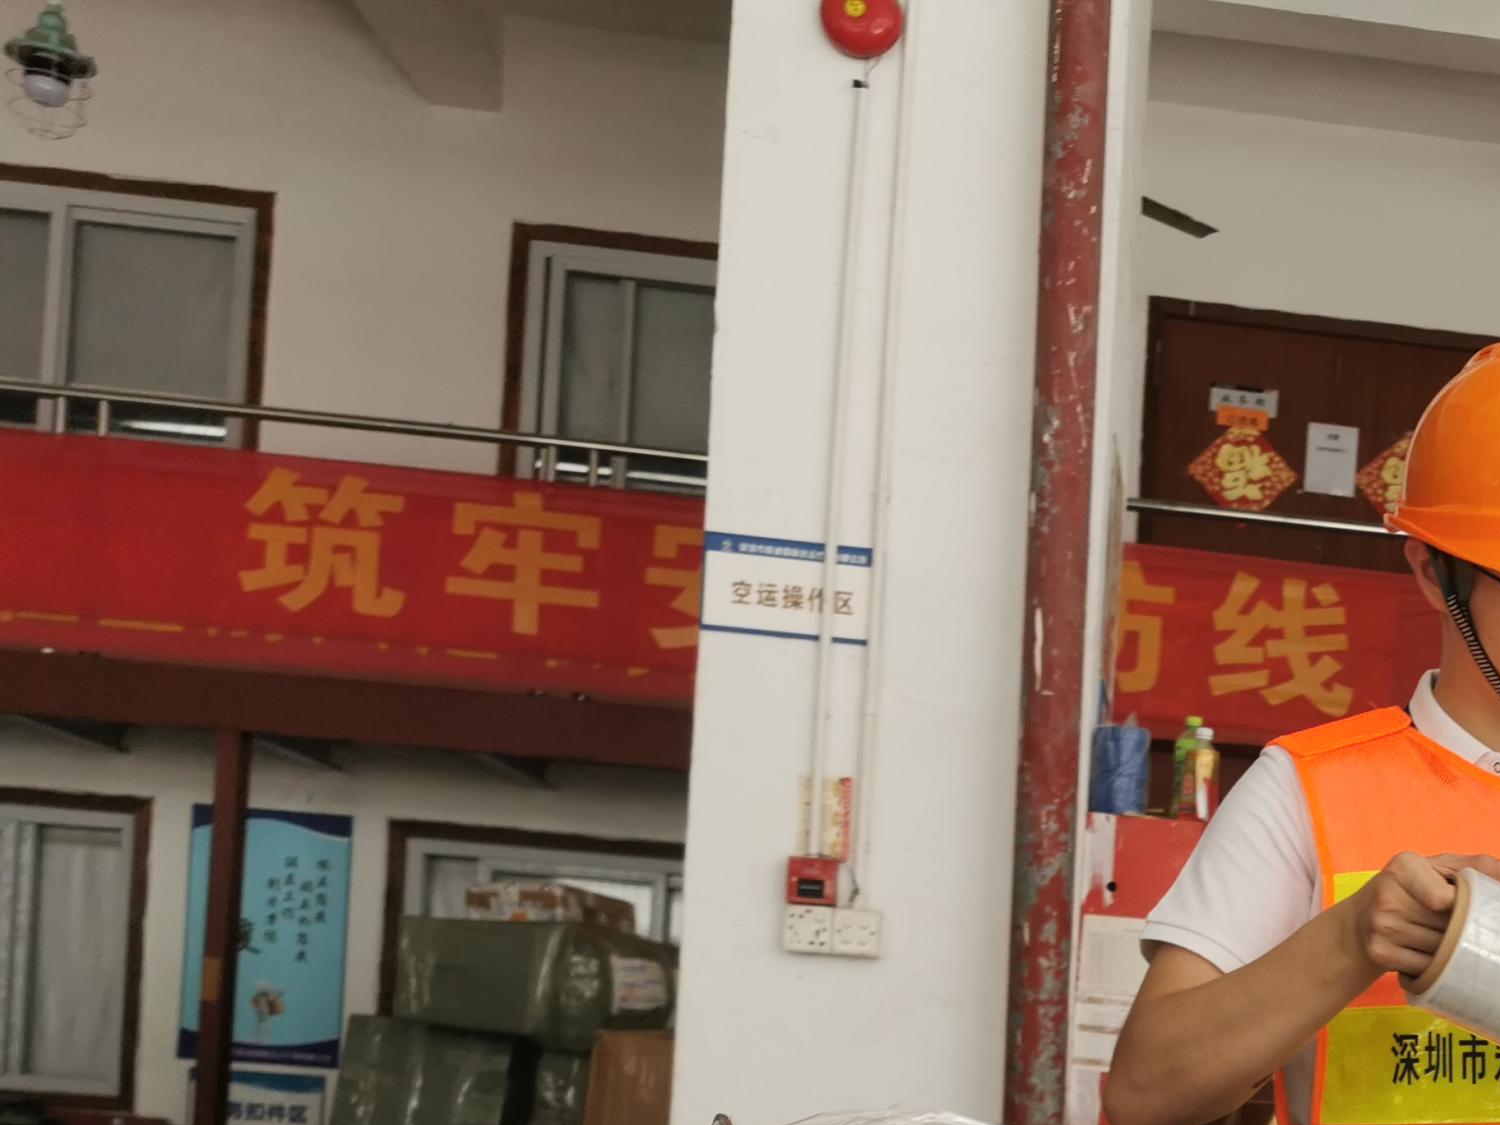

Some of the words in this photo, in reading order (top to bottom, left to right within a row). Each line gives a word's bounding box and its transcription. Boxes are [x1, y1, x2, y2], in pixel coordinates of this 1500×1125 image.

[730, 580, 854, 616] 空运操作区
